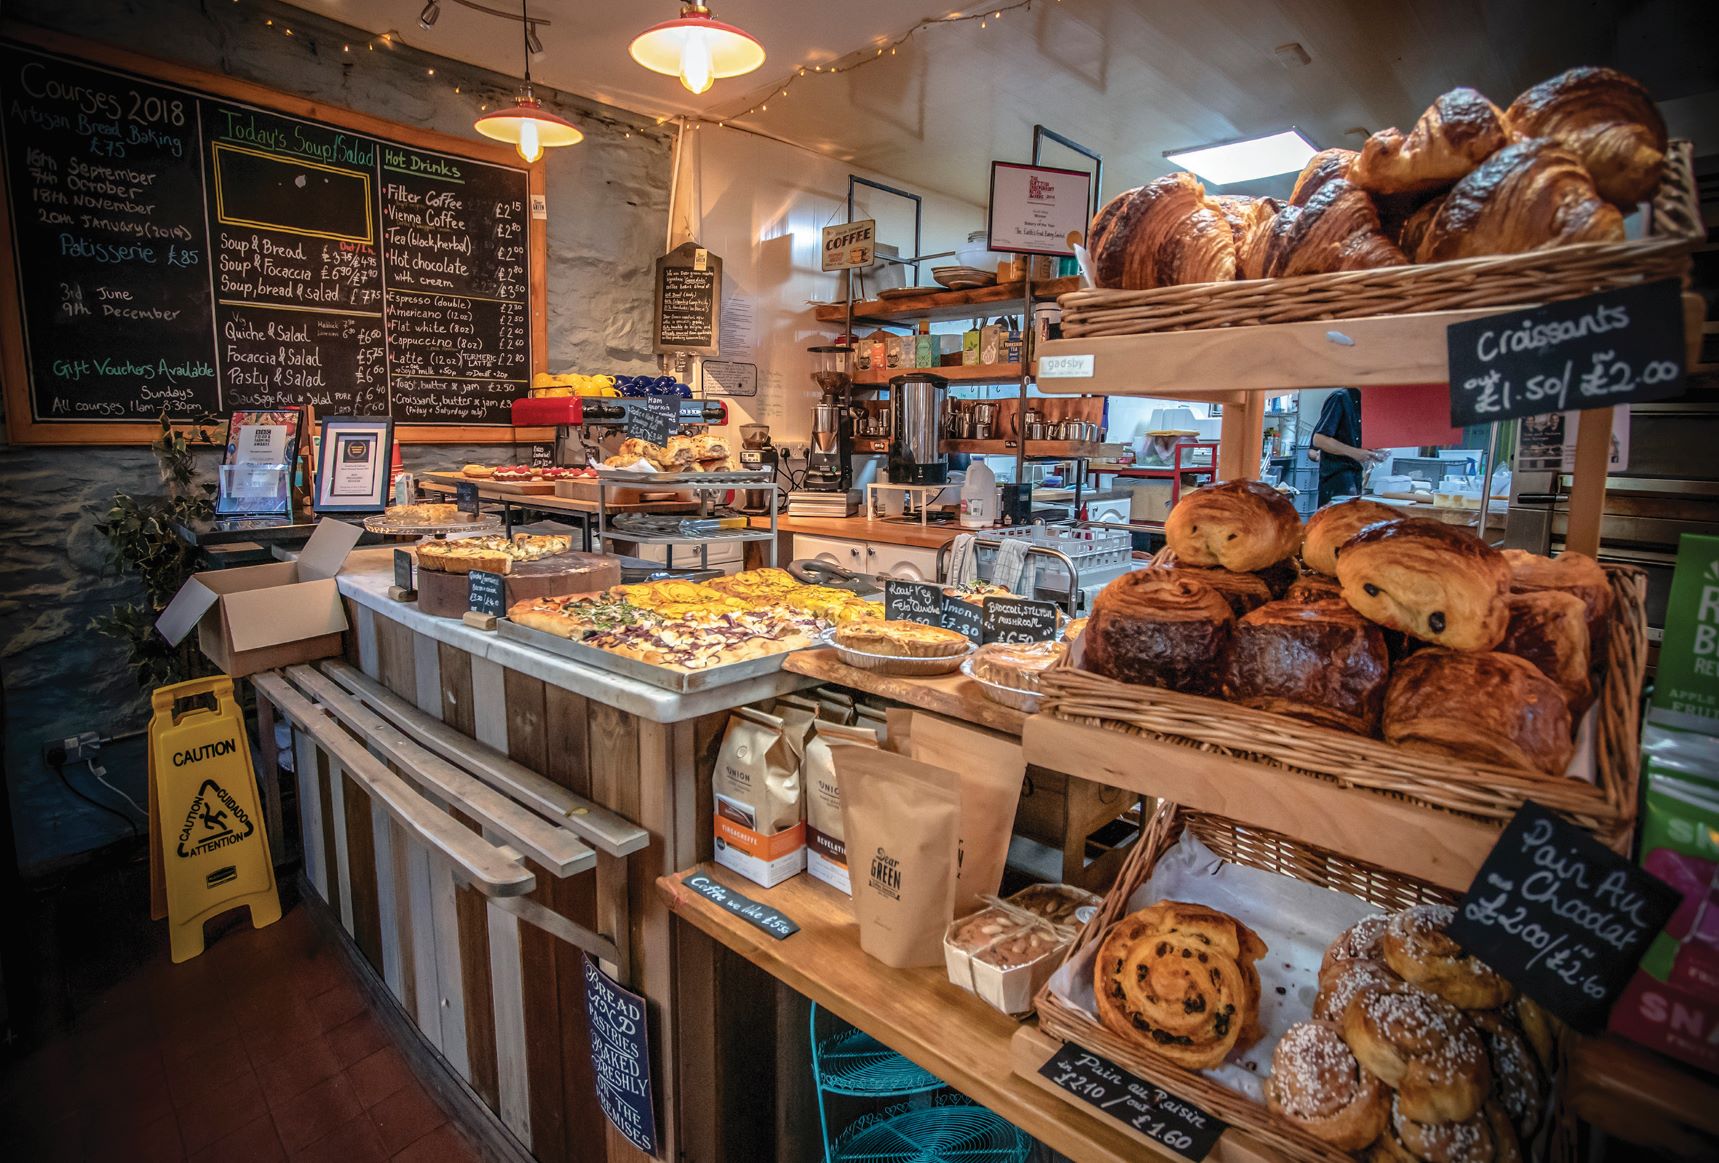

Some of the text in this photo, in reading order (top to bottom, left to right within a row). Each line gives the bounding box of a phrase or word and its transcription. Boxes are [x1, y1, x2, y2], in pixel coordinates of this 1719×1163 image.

[21, 62, 185, 126] Courses 2018
[10, 100, 183, 157] Artisan Bread Baking
[218, 108, 287, 151] Today's
[90, 137, 126, 158] £75
[67, 157, 157, 185] September
[385, 149, 461, 178] Hot Drinks
[67, 176, 143, 199] October
[387, 184, 421, 204] Filter
[425, 190, 463, 210] Coffee
[74, 195, 156, 214] November
[388, 204, 466, 230] Vienna Coffee
[220, 232, 249, 257] Soup
[262, 239, 307, 260] Bread
[387, 227, 406, 245] Tea
[826, 227, 871, 252] COFFEE
[59, 232, 199, 268] Patisserie £85
[390, 249, 470, 276] Hot chocolate
[220, 253, 251, 277] Soup
[264, 258, 312, 280] Focaccia
[394, 271, 454, 288] with cream
[97, 287, 133, 301] June
[305, 282, 339, 302] salad
[388, 291, 472, 309] Espresso (double)
[62, 303, 181, 321] 9th December
[389, 305, 442, 319] Americano
[225, 321, 266, 343] Quiche
[277, 323, 311, 343] Salad
[391, 320, 411, 332] Flat
[415, 320, 447, 333] white
[1477, 305, 1630, 362] Croissants
[391, 333, 453, 349] Cappuccino
[227, 345, 276, 365] Focaccia
[288, 346, 322, 367] Salad
[392, 351, 424, 365] Latte
[1048, 357, 1085, 371] gadsby
[52, 359, 91, 381] Gift
[158, 358, 215, 384] Available
[227, 367, 269, 393] Pasty
[284, 369, 326, 387] Salad
[1464, 369, 1501, 390] out
[1580, 360, 1679, 396] £2.00
[141, 385, 194, 401] Sundays
[228, 388, 276, 408] Sausage
[276, 391, 295, 404] Roll
[307, 391, 333, 405] Salad
[461, 381, 480, 394] jam
[648, 396, 663, 404] Ham
[52, 396, 155, 415] All courses 11am
[442, 395, 472, 406] butter
[482, 397, 498, 409] jam
[889, 583, 914, 596] Roast
[998, 616, 1042, 628] MUSHROOM
[173, 739, 236, 767] CAUTION
[726, 766, 750, 782] UNION
[217, 788, 249, 823] CUIDADO
[179, 796, 204, 842] CAUTION
[190, 832, 244, 858] ATTENTION
[876, 847, 899, 868] Dear
[1520, 818, 1590, 890] Pain
[871, 858, 901, 890] GREEN
[691, 877, 726, 901] Coffee
[727, 900, 740, 910] we
[741, 904, 762, 919] like
[1521, 870, 1639, 950] Chocolat
[585, 960, 641, 1021] BREAD
[588, 989, 636, 1036] AND
[588, 1002, 639, 1058] PASTRIES
[590, 1028, 640, 1077] BAKED
[591, 1054, 649, 1097] FRESHLY
[1057, 1060, 1150, 1113] in out
[1074, 1052, 1208, 1130] Pain au Raisin
[596, 1084, 651, 1150] PREMISES
[615, 1096, 641, 1129] THE
[1131, 1113, 1193, 1150] £1.60
